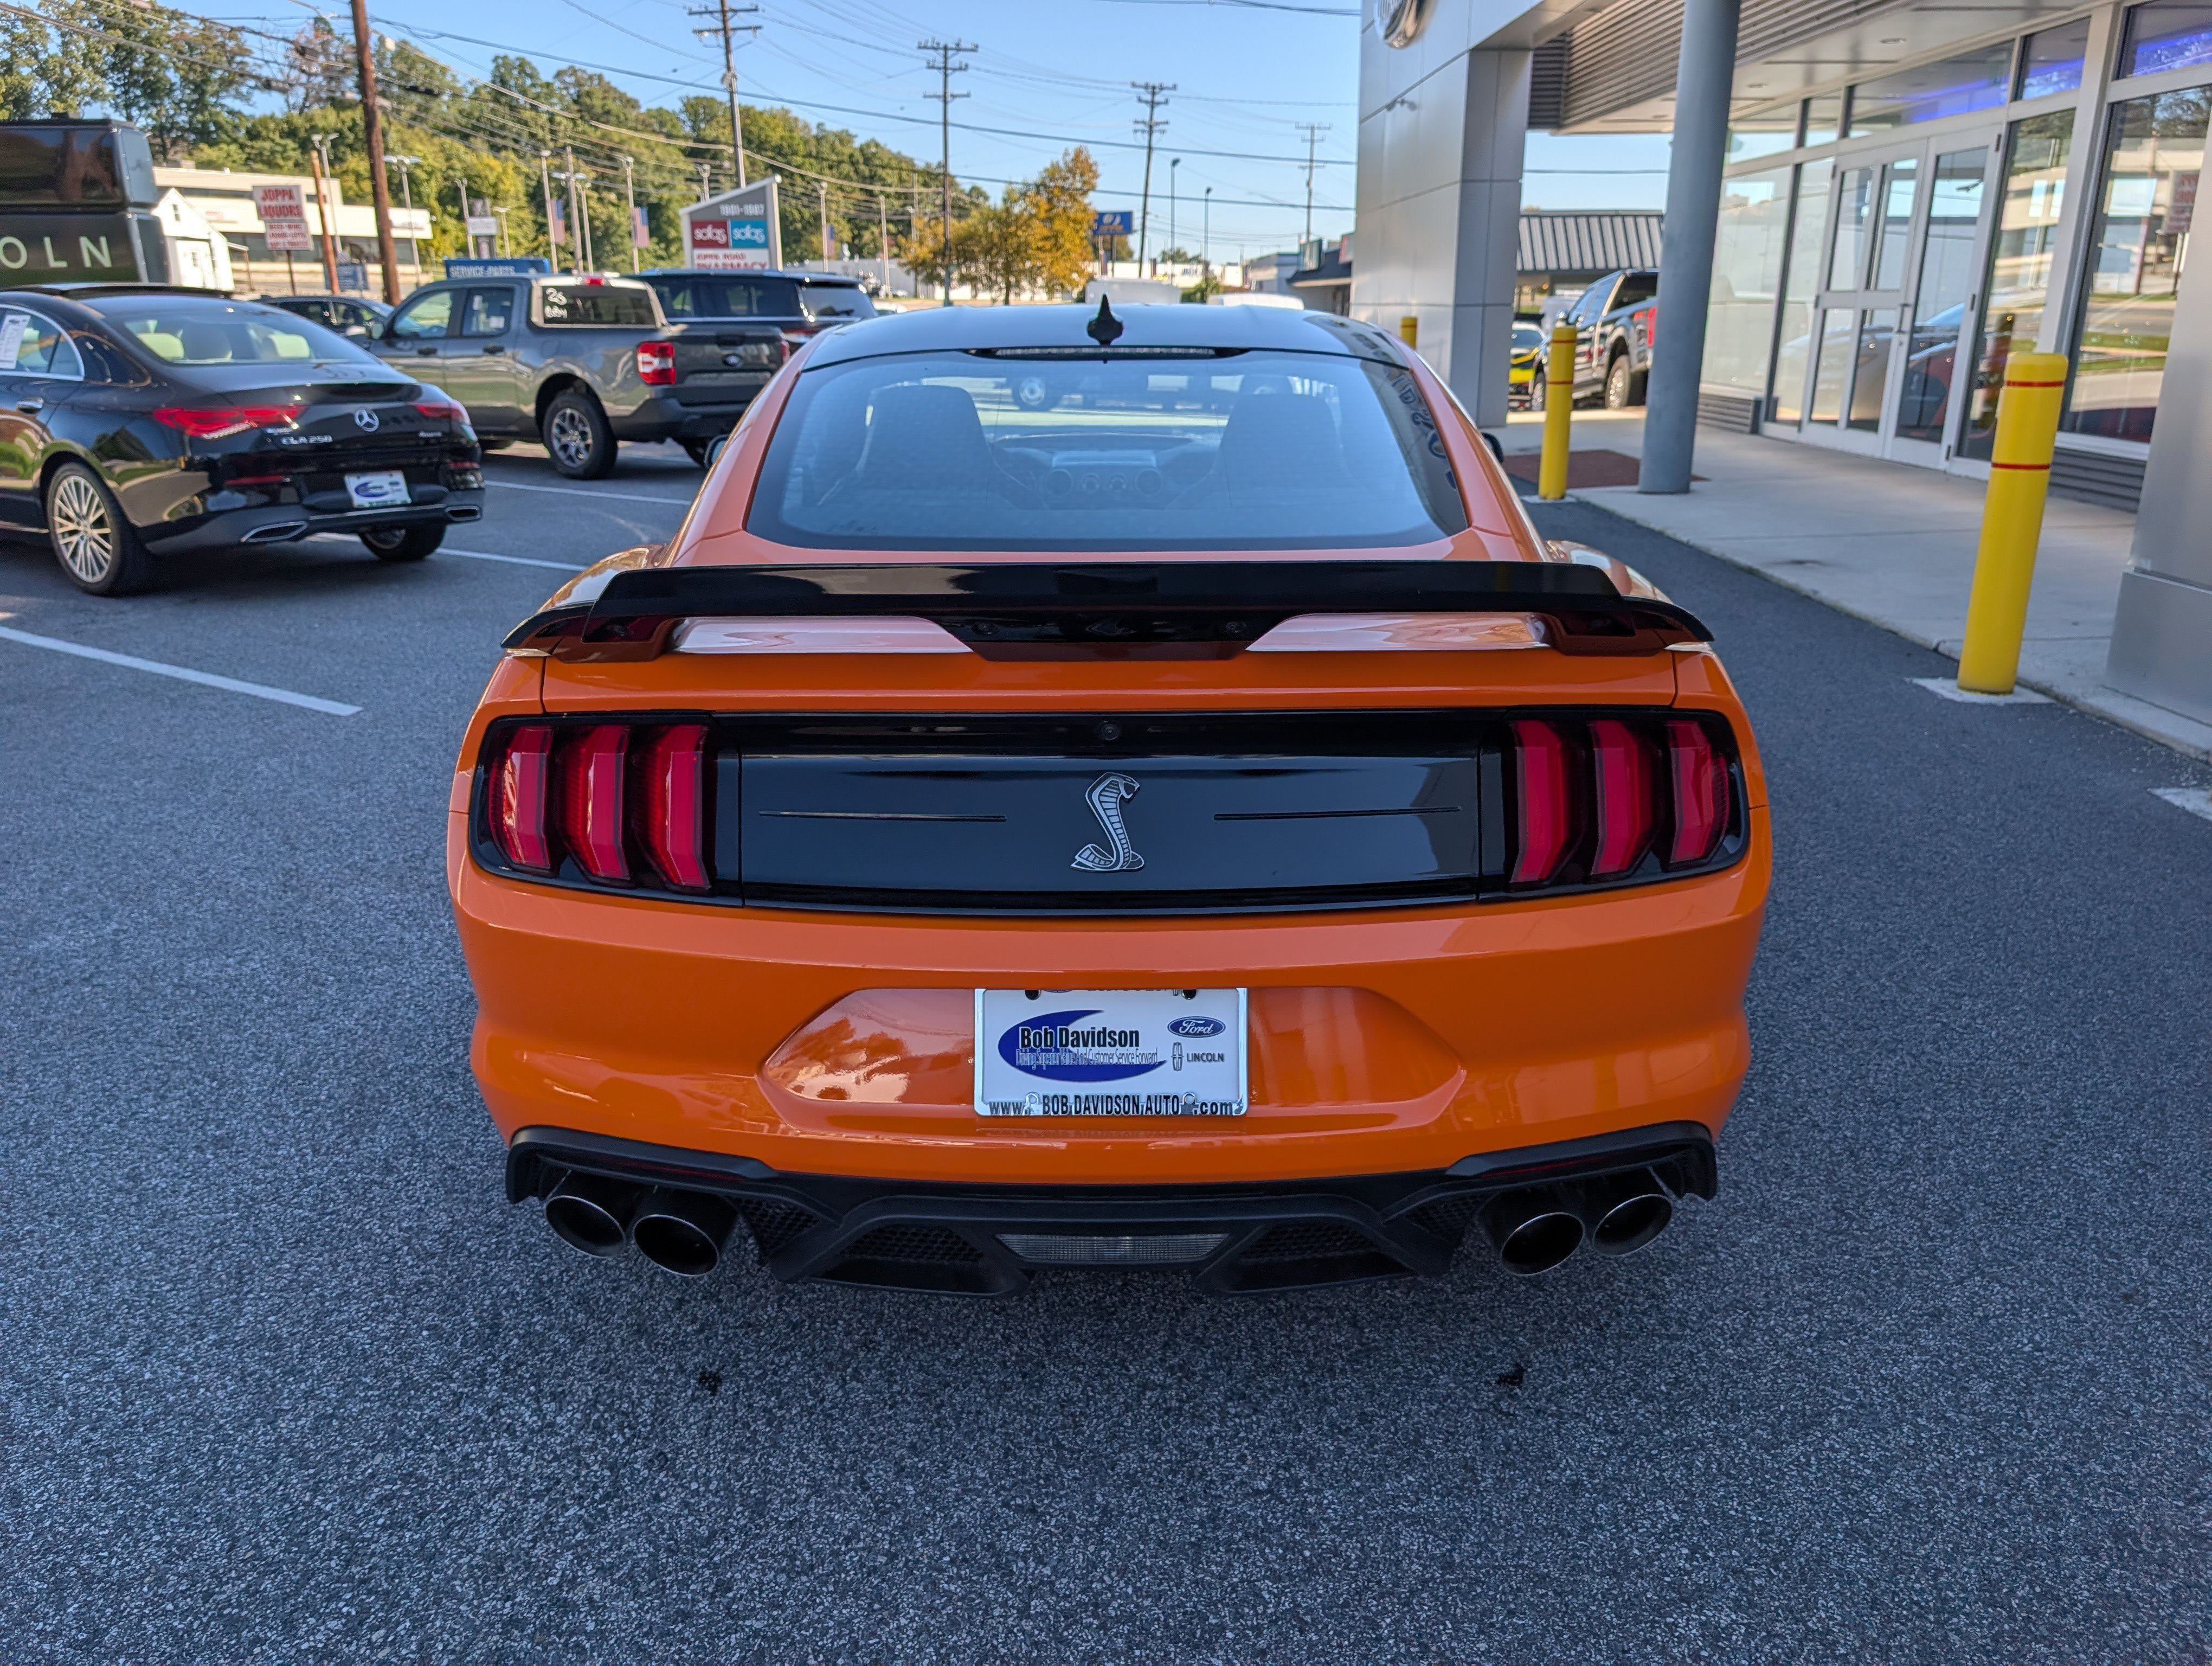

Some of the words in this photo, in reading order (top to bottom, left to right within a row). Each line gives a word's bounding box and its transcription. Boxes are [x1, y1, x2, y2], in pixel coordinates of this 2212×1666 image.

[261, 189, 295, 202] JOPPA
[258, 204, 303, 218] LIQUORS
[281, 436, 308, 445] CLA
[308, 435, 333, 444] 250
[1179, 1019, 1214, 1034] Ford
[1020, 1027, 1055, 1048] Bob
[1058, 1027, 1140, 1048] Davidson
[1015, 1048, 1036, 1071] Driving
[1036, 1048, 1060, 1071] Superior
[1088, 1048, 1115, 1065] Customer
[1115, 1047, 1135, 1065] Service
[1135, 1047, 1159, 1065] Forward
[1186, 1052, 1225, 1063] LINCOLN
[1042, 1094, 1069, 1115] BOB
[1074, 1094, 1140, 1115] DAVIDSON
[1144, 1094, 1180, 1115] AUTO
